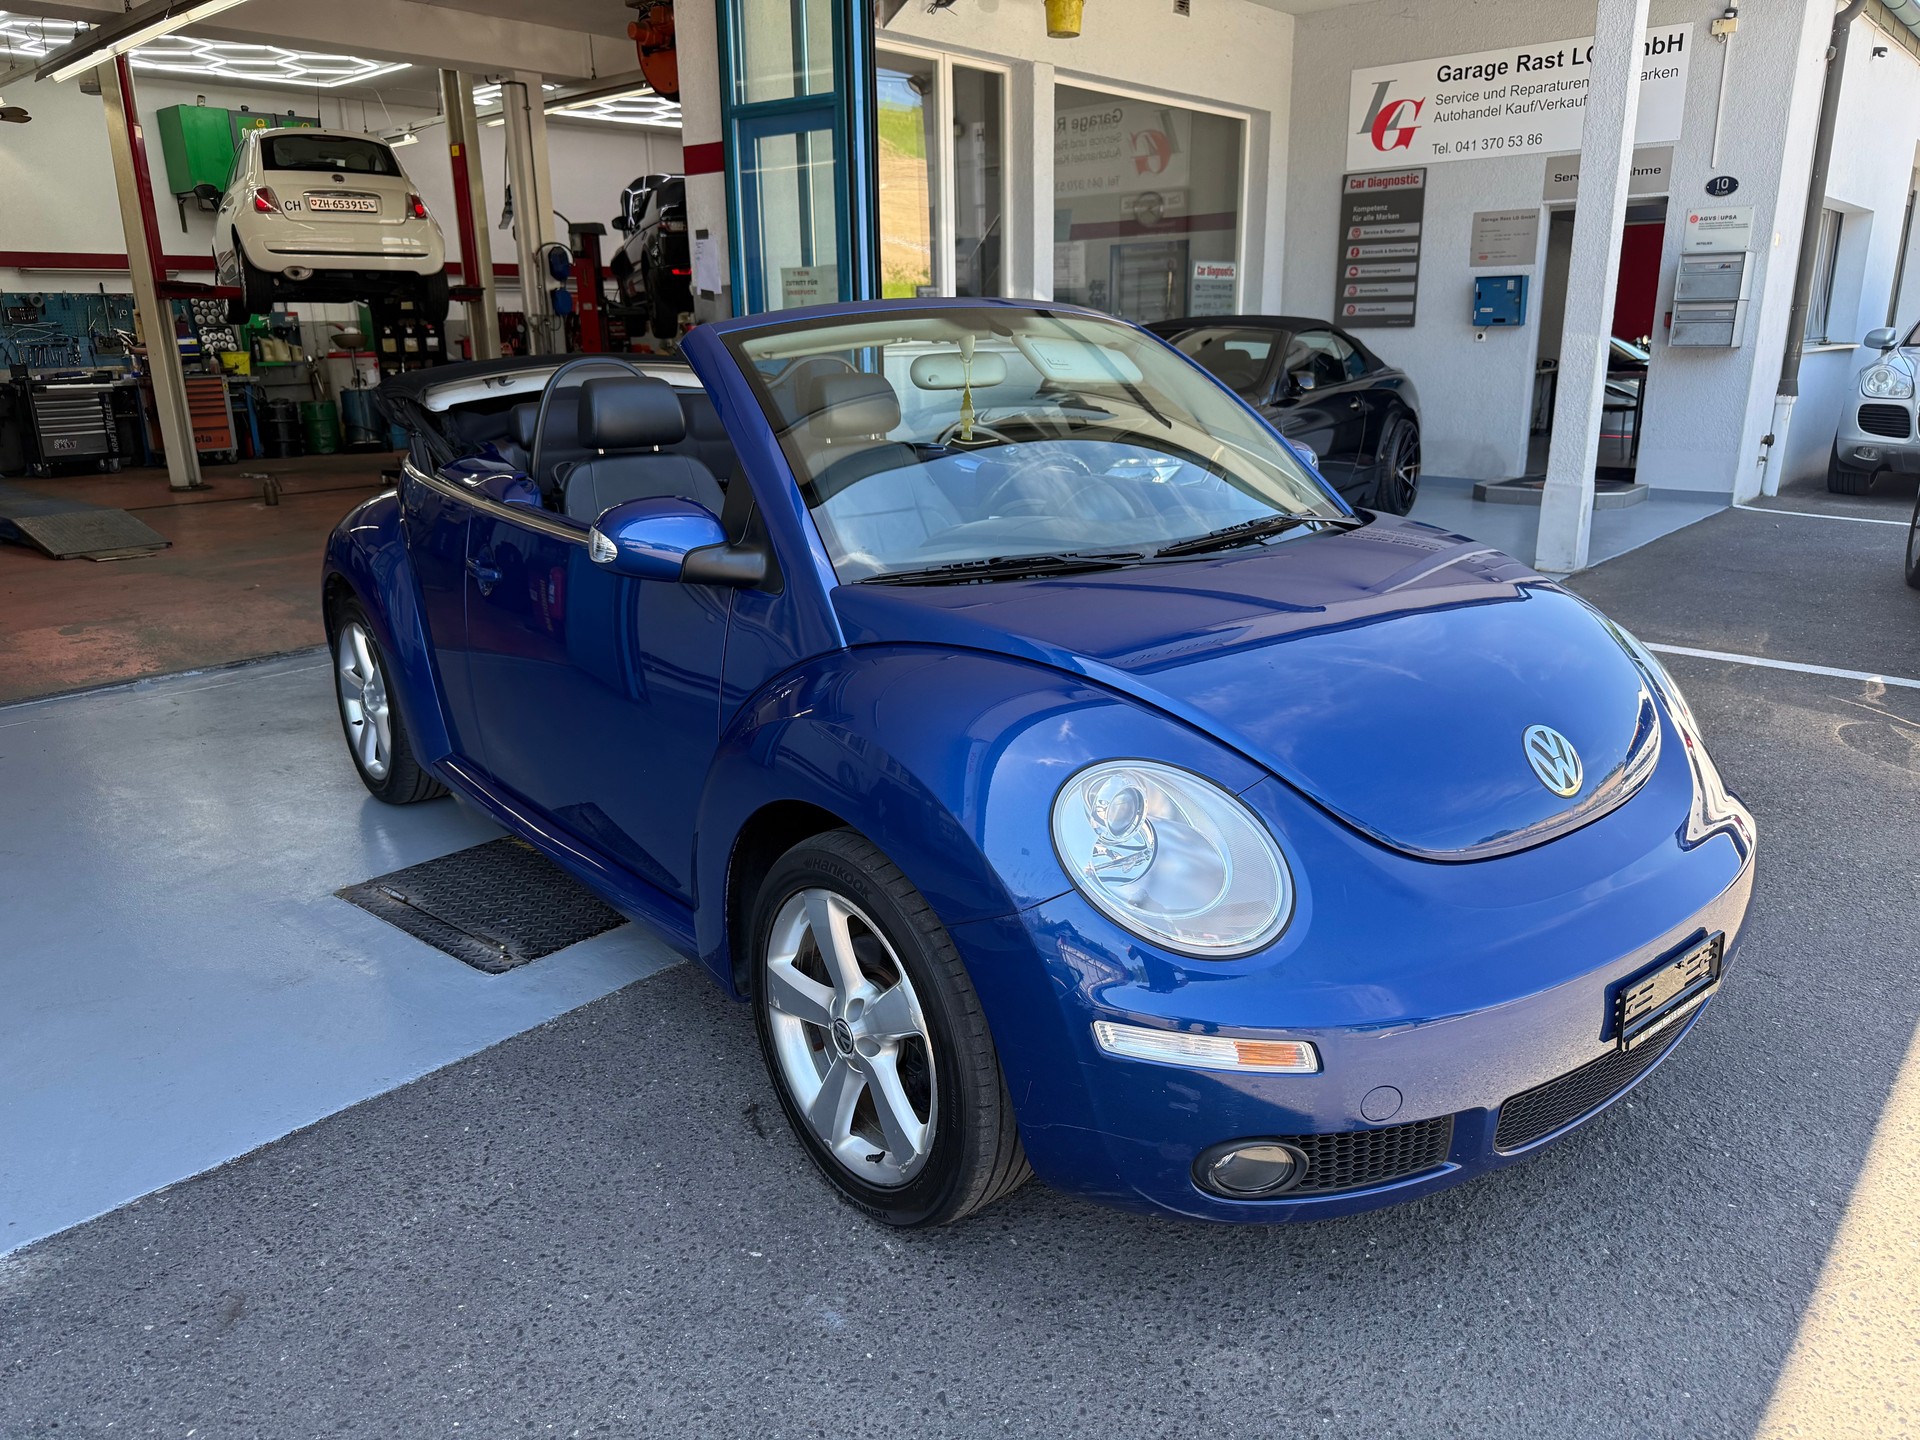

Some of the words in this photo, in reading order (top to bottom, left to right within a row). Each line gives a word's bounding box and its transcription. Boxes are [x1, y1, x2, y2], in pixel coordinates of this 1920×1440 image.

[1436, 61, 1509, 83] Garage
[1516, 50, 1564, 73] Rast
[1435, 91, 1480, 106] Service
[1483, 86, 1507, 100] und
[1510, 78, 1590, 98] Reparaturen
[1640, 67, 1679, 82] arken
[1433, 105, 1502, 123] Autohandel
[1505, 94, 1588, 116] Kauf/Verkauf
[1432, 142, 1452, 155] Tel.
[1455, 140, 1476, 153] 041
[1481, 136, 1504, 150] 370
[1507, 135, 1523, 148] 53
[1526, 133, 1543, 146] 86
[1350, 178, 1366, 189] Car
[1368, 173, 1419, 189] Diagnostic
[1716, 178, 1729, 190] 10
[284, 200, 302, 211] CH
[1353, 204, 1388, 213] Kompetenz
[1352, 214, 1362, 222] für
[1363, 213, 1374, 221] alle
[194, 434, 212, 443] eta
